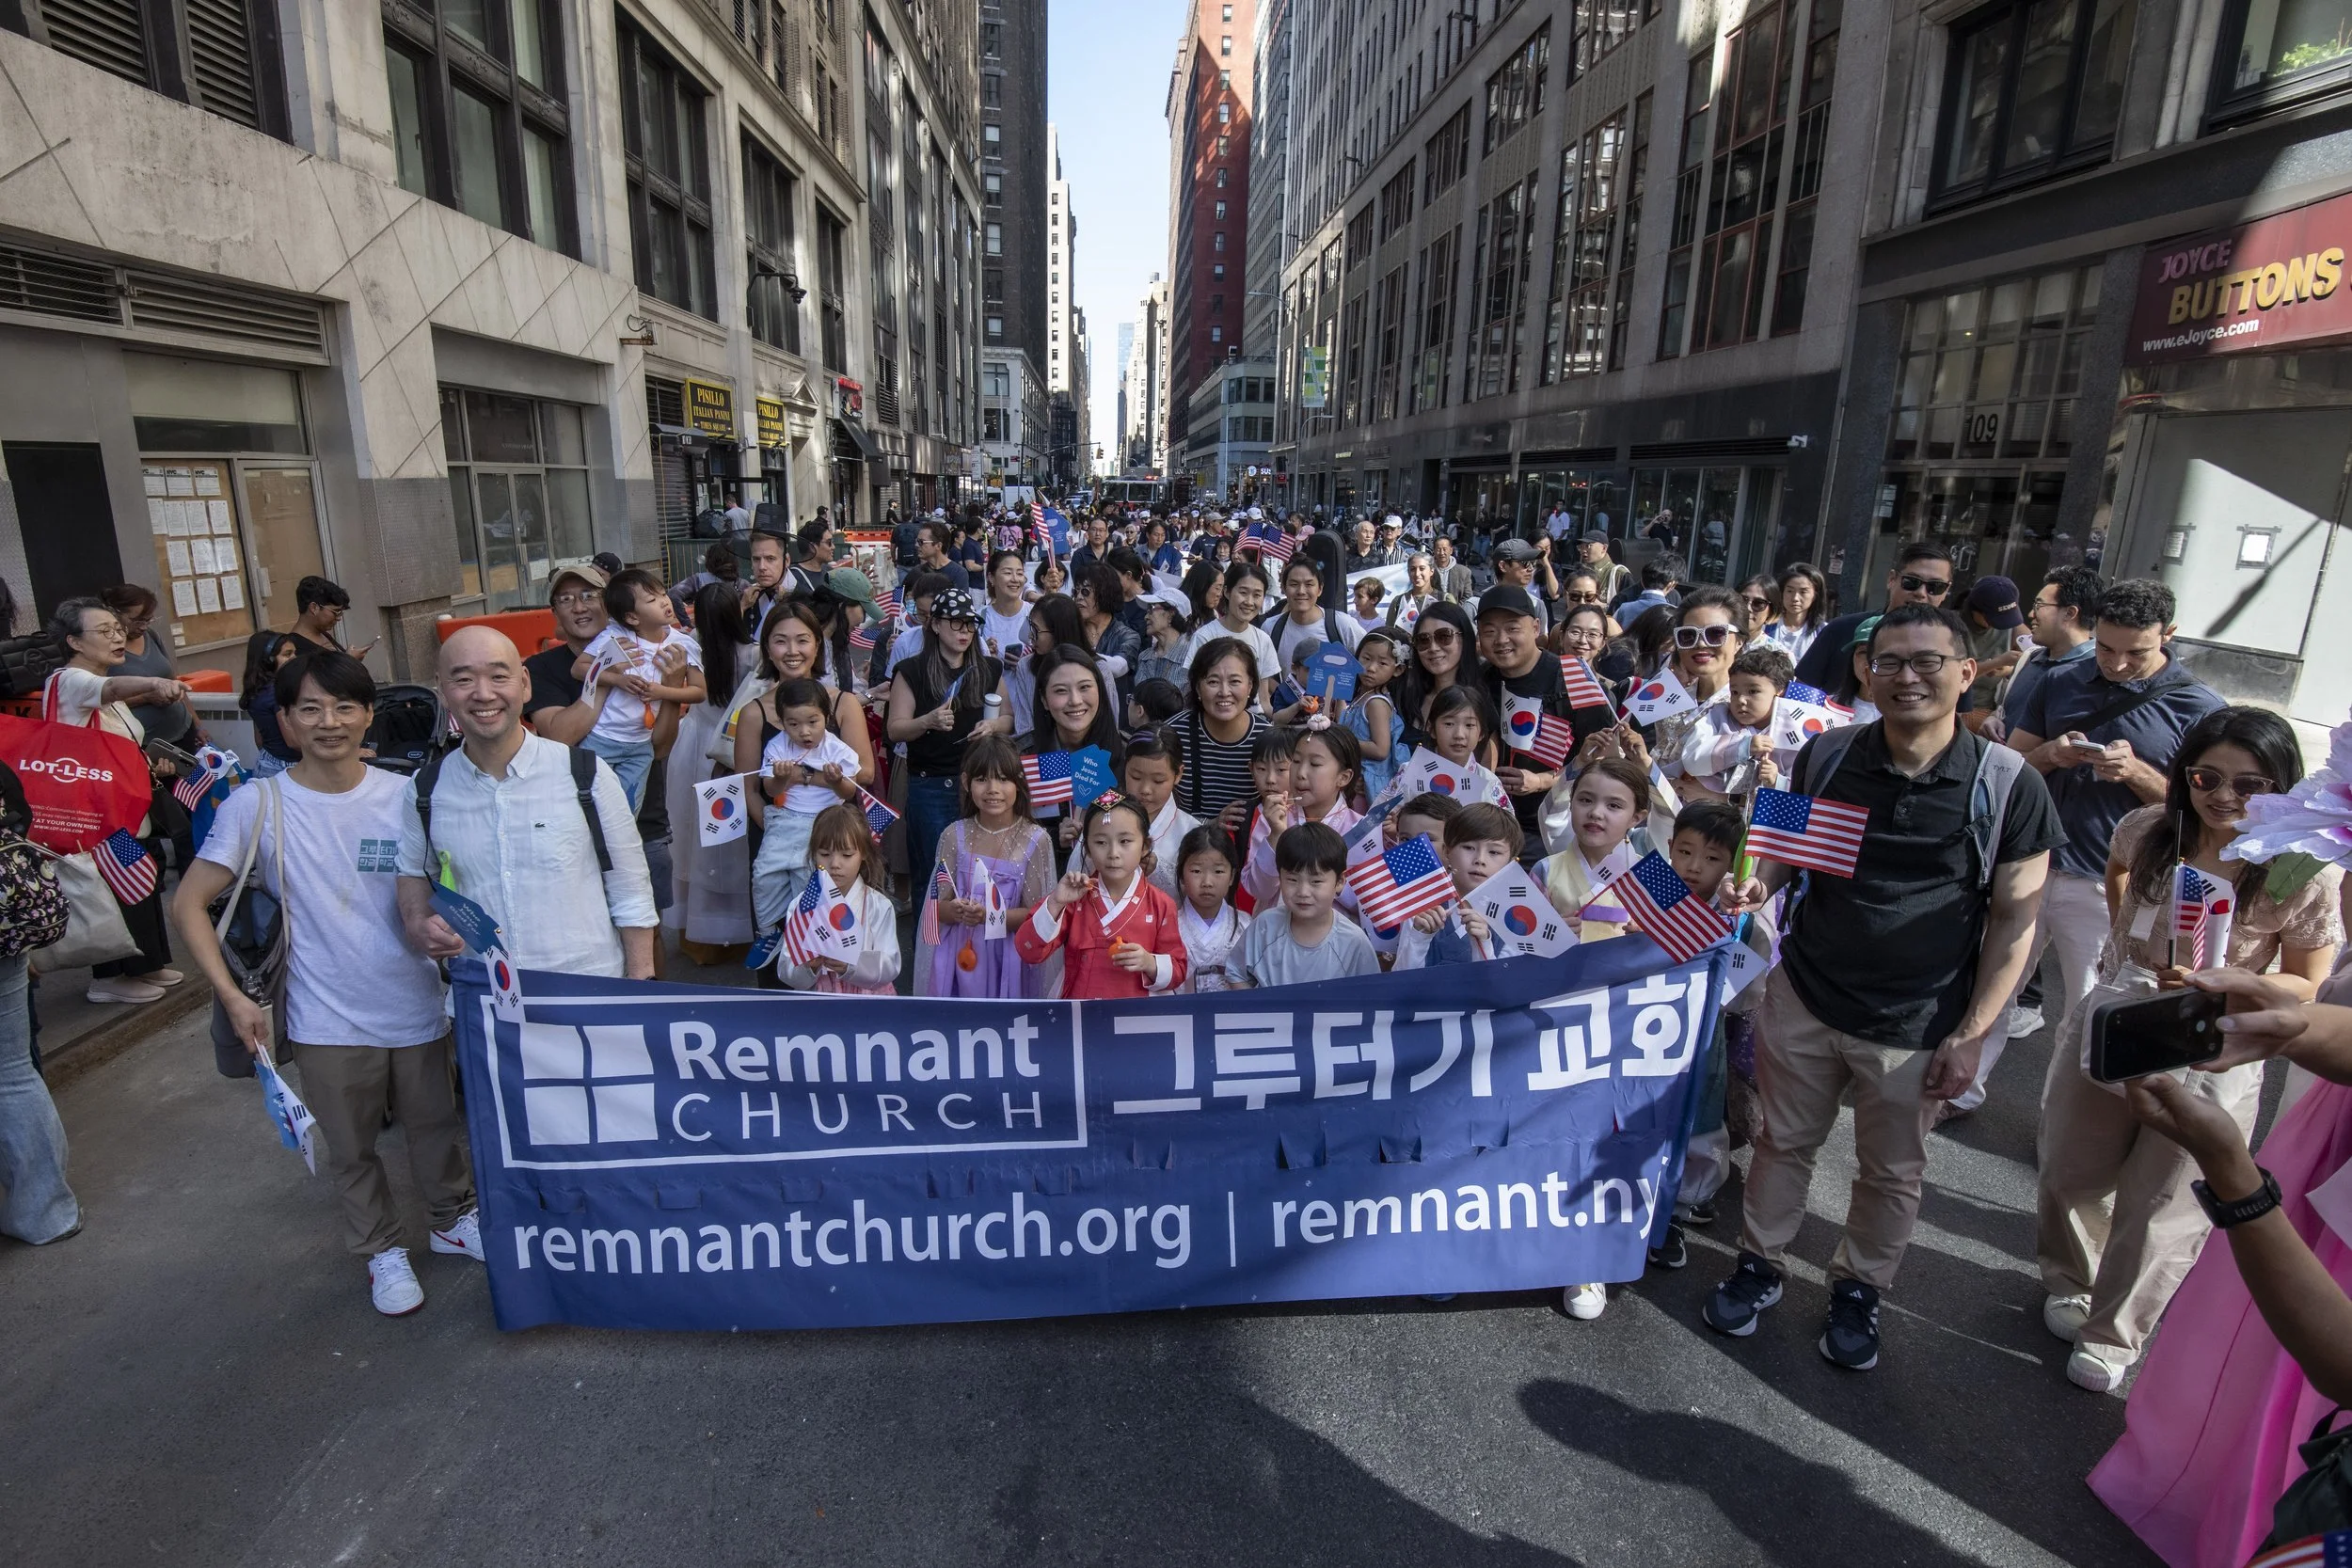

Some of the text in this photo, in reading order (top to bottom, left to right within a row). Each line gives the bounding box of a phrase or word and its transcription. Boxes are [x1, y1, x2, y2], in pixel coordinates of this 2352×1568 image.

[2158, 239, 2233, 283] JOYCE
[2168, 246, 2344, 325] BUTTONS
[2143, 318, 2260, 353] www.eJoyce.com
[697, 388, 724, 407] PISILLO
[693, 405, 731, 421] ITALIAN PANINI
[758, 403, 779, 419] PISILLO
[713, 422, 726, 432] SQUARE
[1965, 413, 1997, 446] 109
[20, 759, 113, 783] LOT-LESS
[1081, 766, 1098, 777] Jesus
[1084, 756, 1098, 768] Who
[1074, 771, 1100, 786] Died For
[360, 845, 395, 855] 그루 터기
[359, 858, 375, 866] 한글
[449, 905, 481, 935] Died For
[458, 908, 478, 927] Jesus
[463, 903, 481, 922] Who
[669, 1014, 1040, 1083] Remnant
[1113, 971, 1708, 1113] 그루터기 교회
[672, 1090, 1041, 1142] CHURCH
[514, 1191, 1191, 1275] remnantchurch.org
